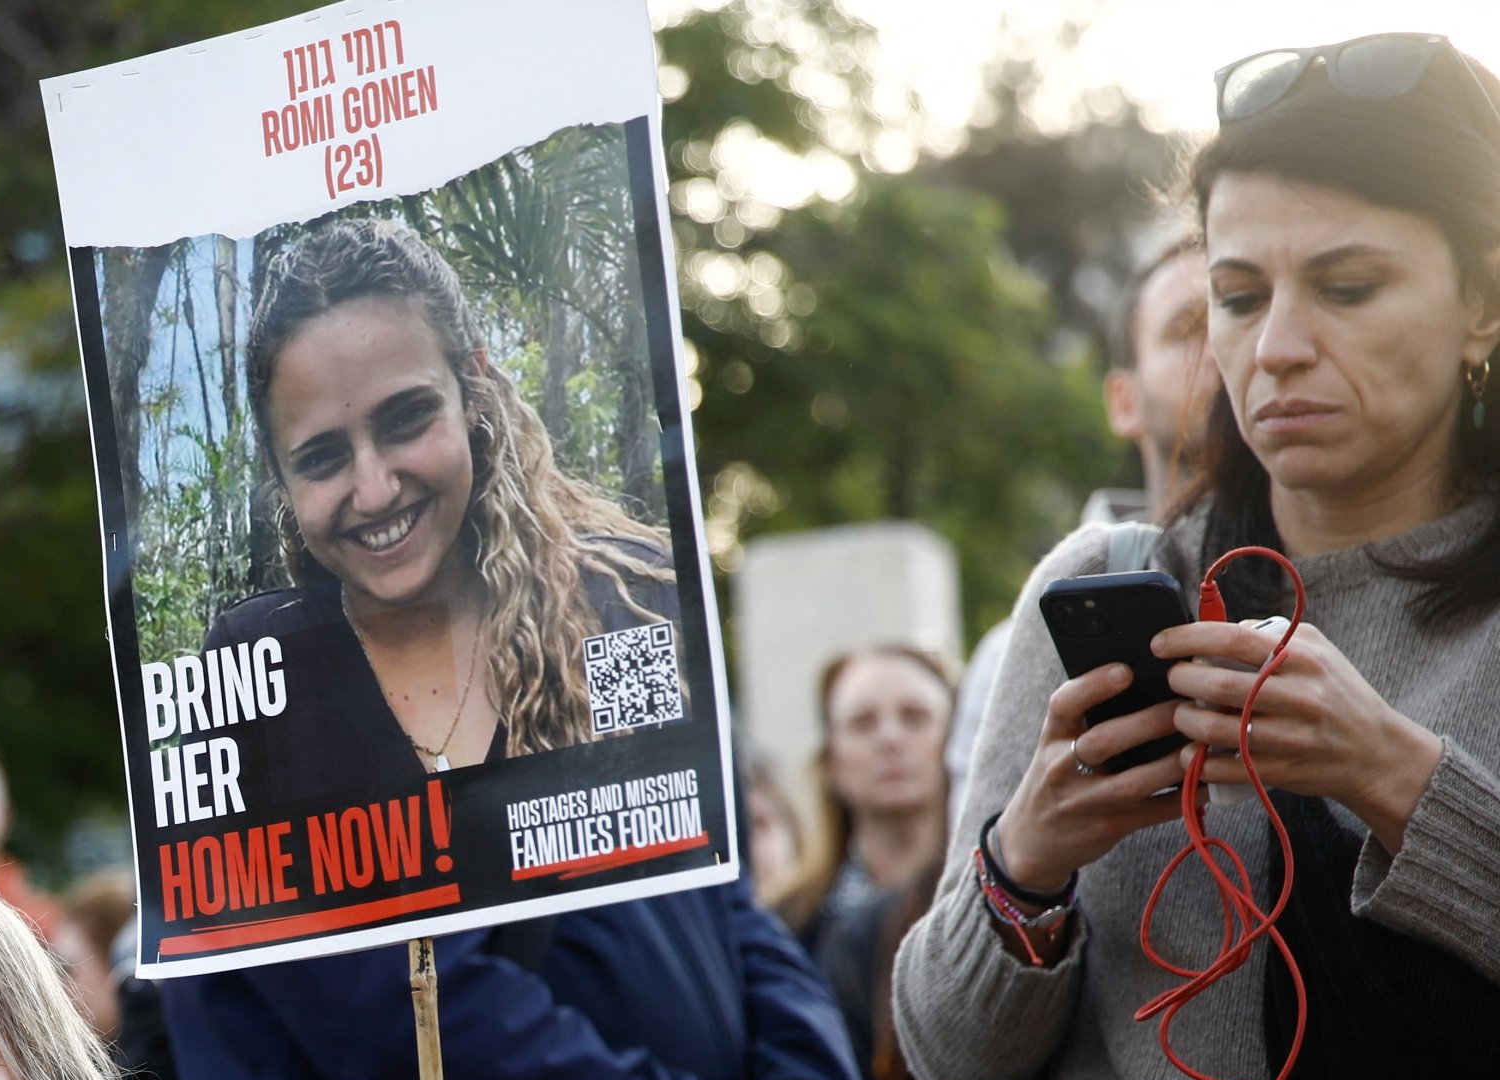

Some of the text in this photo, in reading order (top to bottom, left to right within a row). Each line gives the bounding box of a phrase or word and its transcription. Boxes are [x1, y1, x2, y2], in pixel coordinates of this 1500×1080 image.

[283, 20, 404, 101] רומי גונן
[261, 65, 438, 157] ROMI GONEN
[324, 133, 383, 200] (23)
[140, 636, 287, 742] BRING
[149, 736, 247, 828] HER
[506, 768, 699, 831] HOSTAGES AND MISSING
[159, 779, 454, 922] HOME NOW!
[509, 796, 704, 872] FAMILIES FORUM
